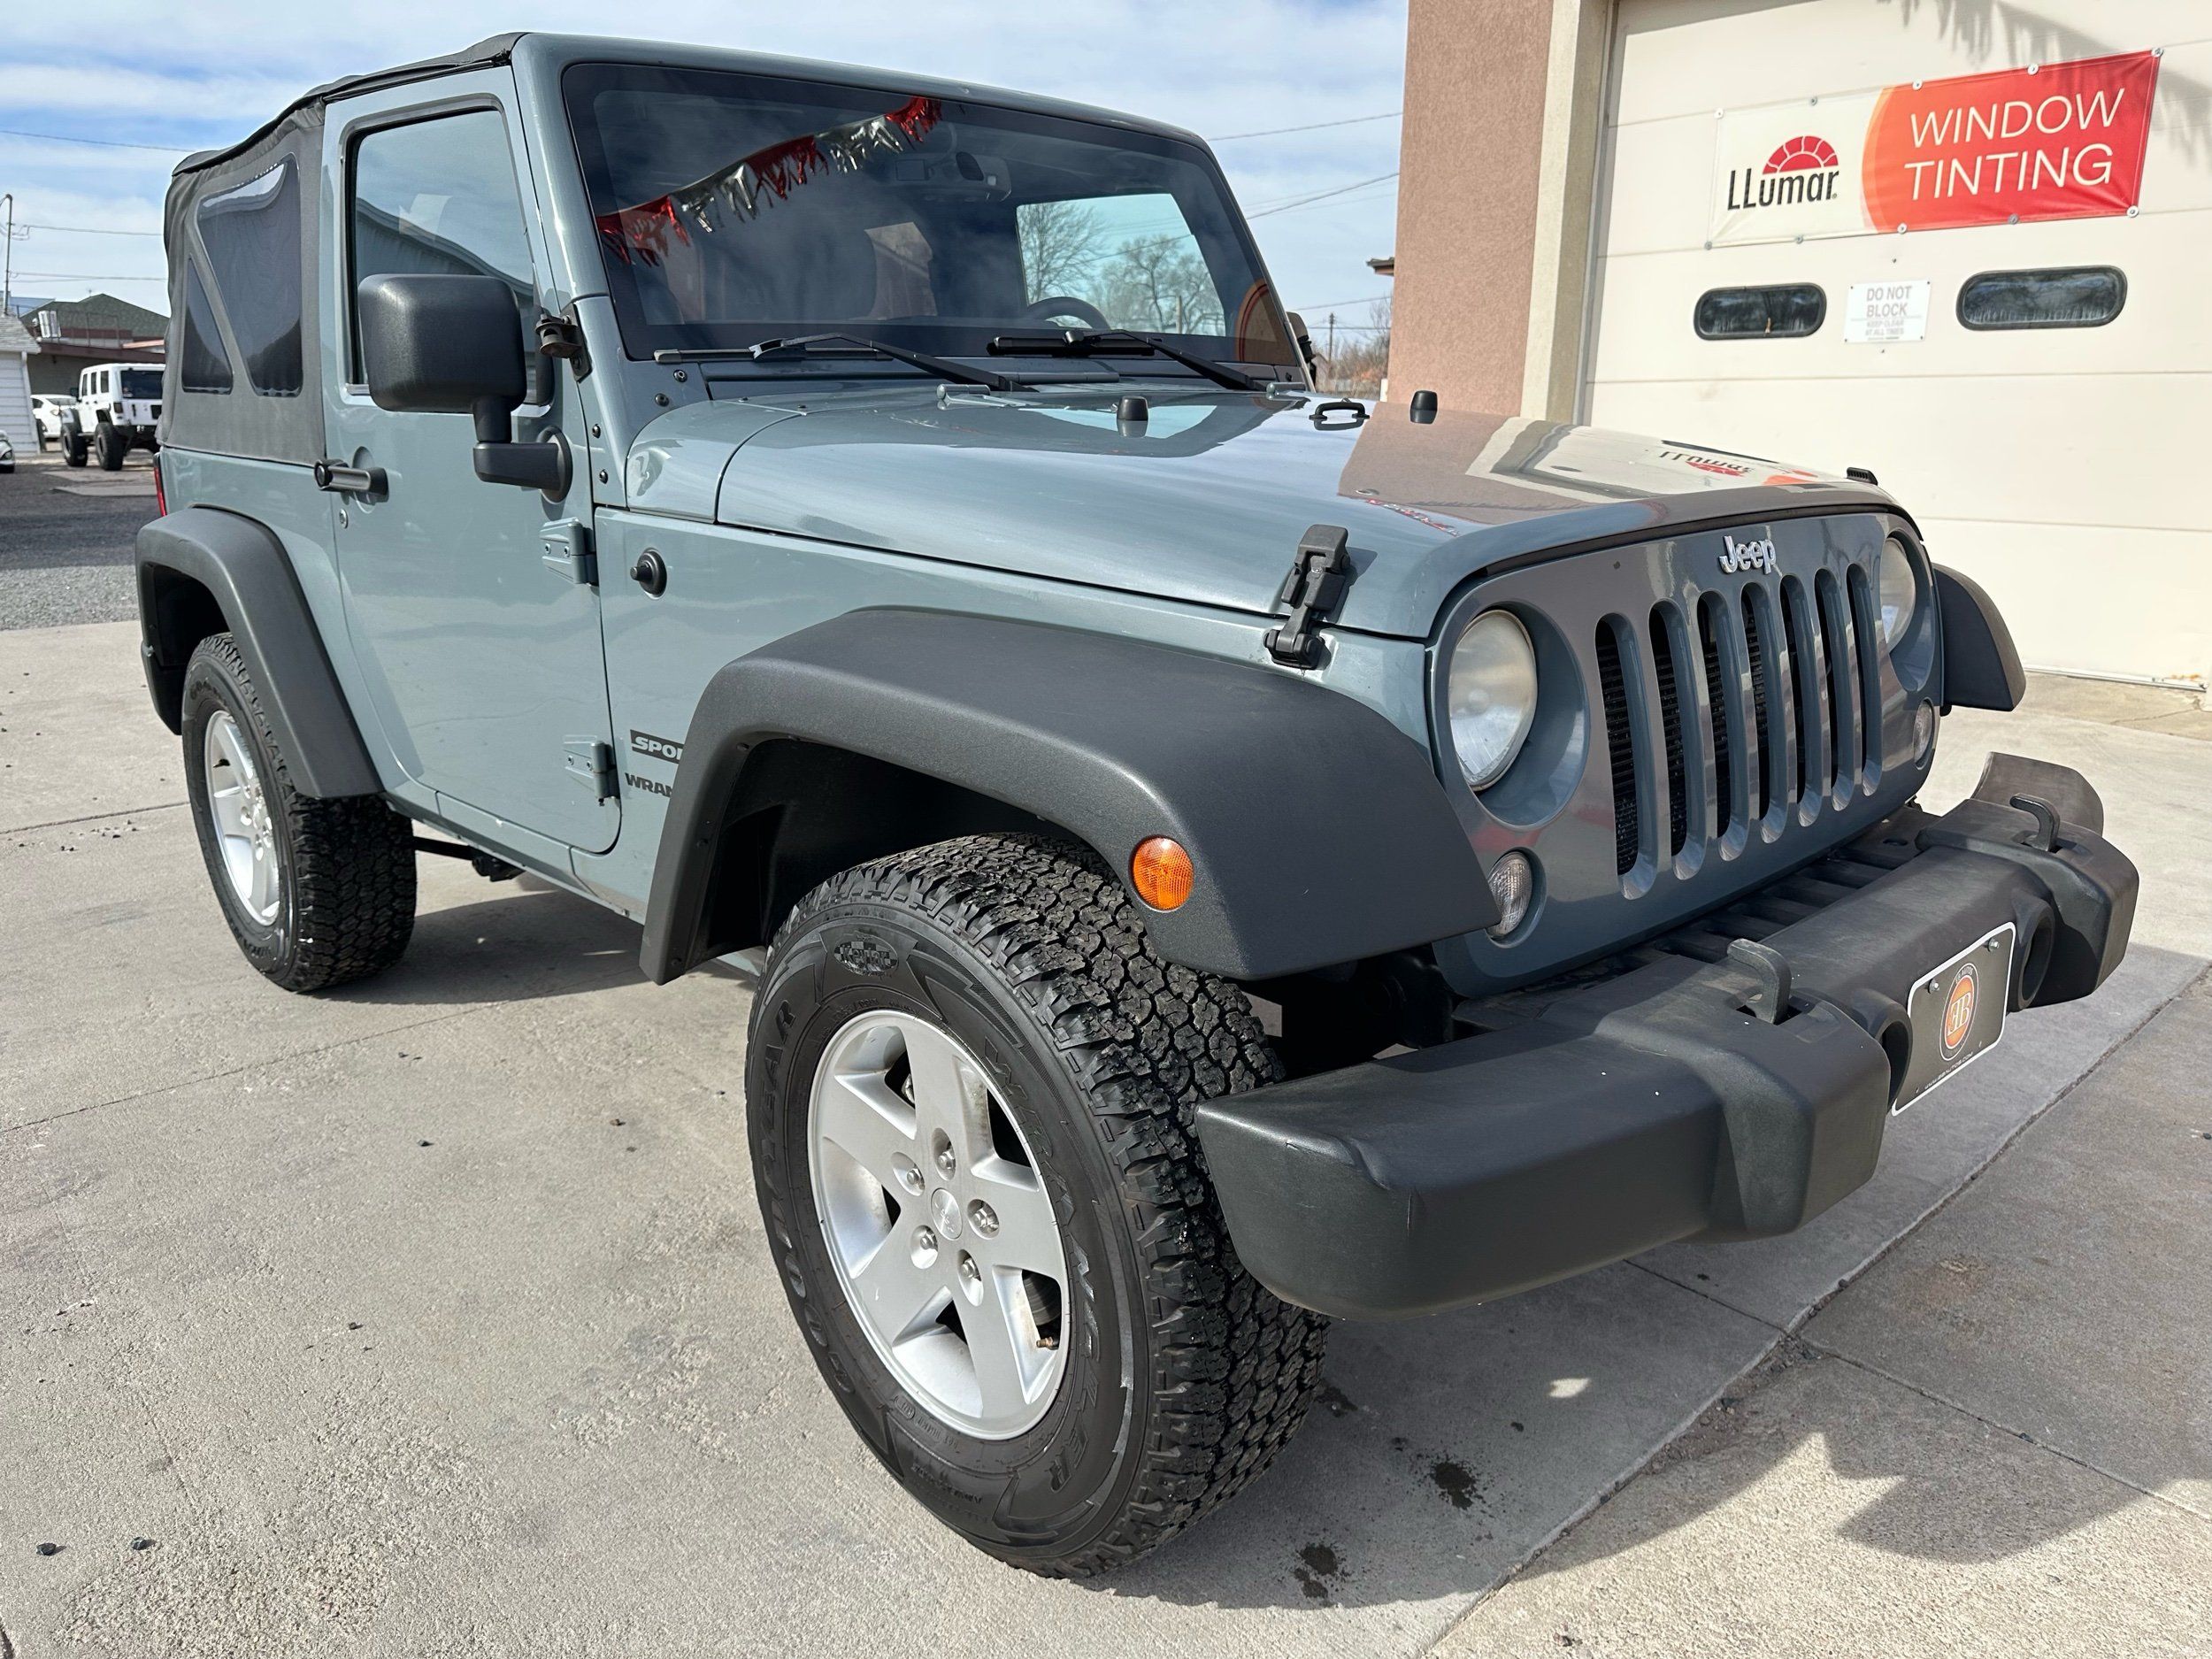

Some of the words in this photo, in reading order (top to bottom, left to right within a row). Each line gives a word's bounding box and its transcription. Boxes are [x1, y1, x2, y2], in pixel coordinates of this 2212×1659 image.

[1910, 88, 2124, 149] WINDOW
[1727, 167, 1839, 211] LLumar
[1904, 142, 2114, 201] TINTING
[1866, 287, 1884, 302] DO
[1886, 285, 1912, 300] NOT
[1867, 303, 1908, 318] BLOCK
[1718, 535, 1777, 575] Jeep
